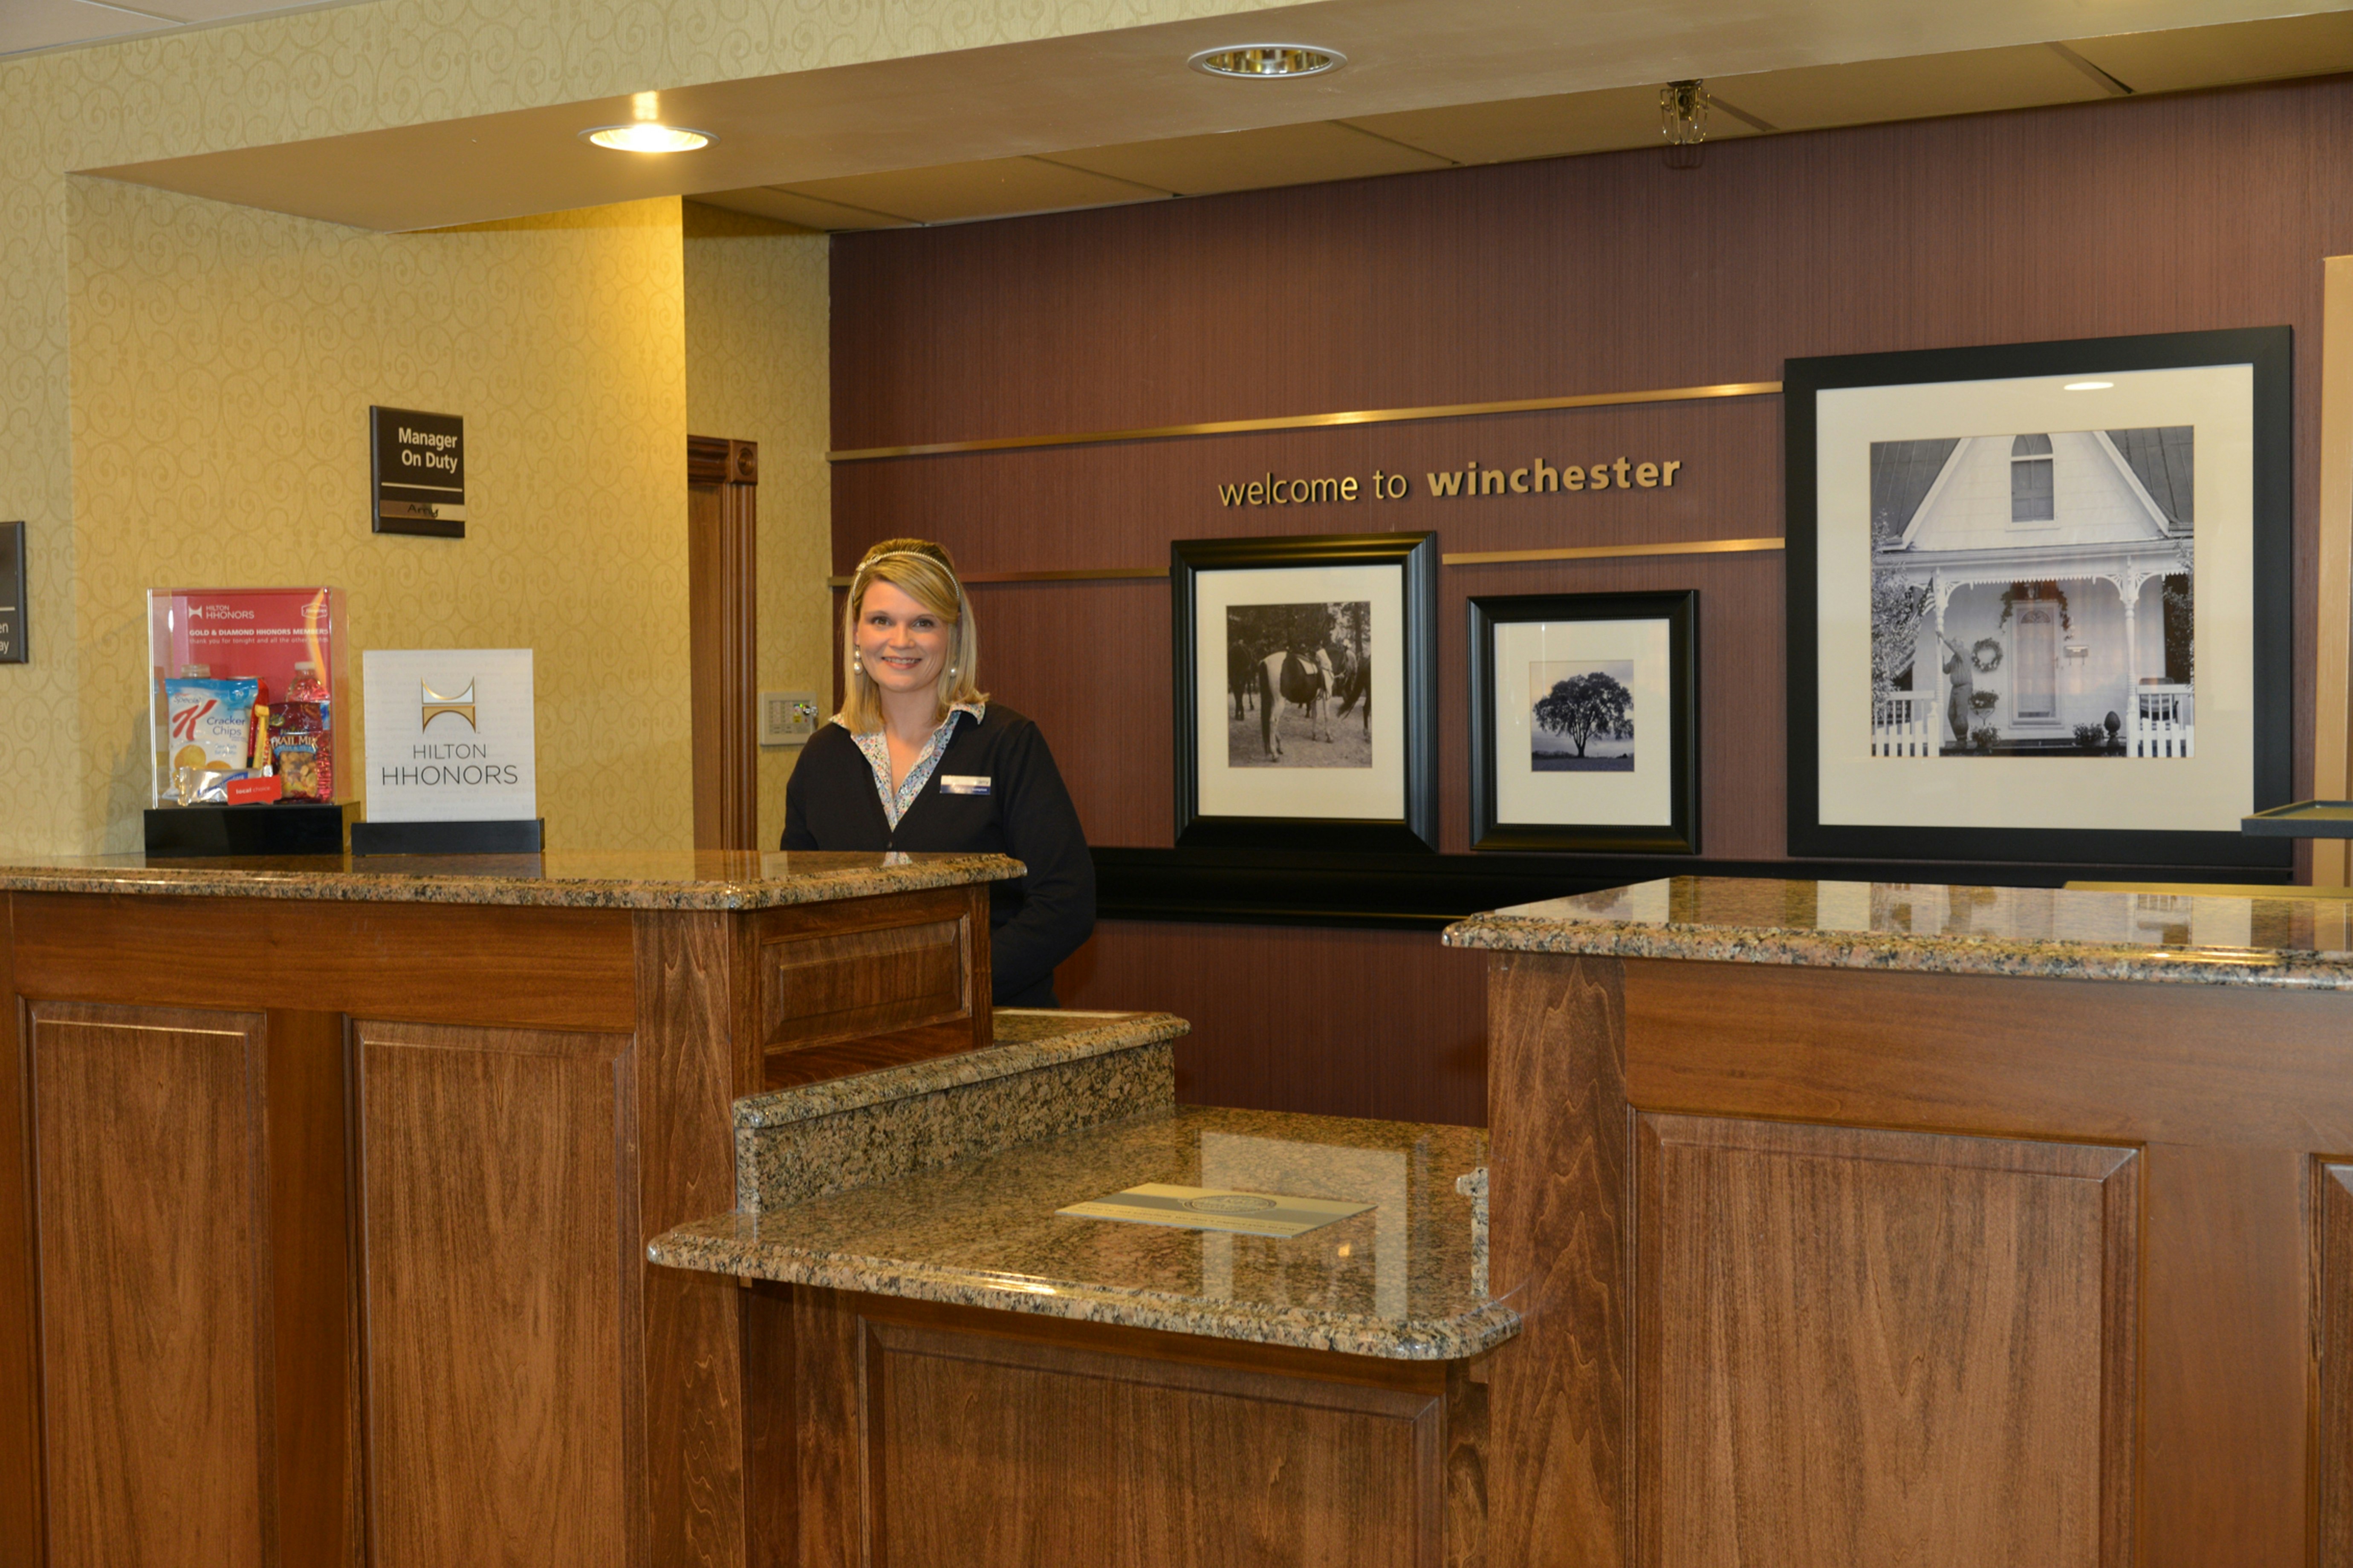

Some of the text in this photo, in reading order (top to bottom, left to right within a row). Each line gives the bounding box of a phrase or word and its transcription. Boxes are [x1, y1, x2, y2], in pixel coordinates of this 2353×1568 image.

[399, 427, 457, 450] Manager
[402, 449, 458, 474] On Duty
[1218, 456, 1682, 507] welcome to winchester
[206, 610, 254, 619] HHONORS
[172, 699, 217, 741] K
[207, 716, 245, 725] Cracker
[213, 726, 242, 738] Chips
[413, 744, 486, 760] HILTON
[382, 765, 518, 786] HHONORS
